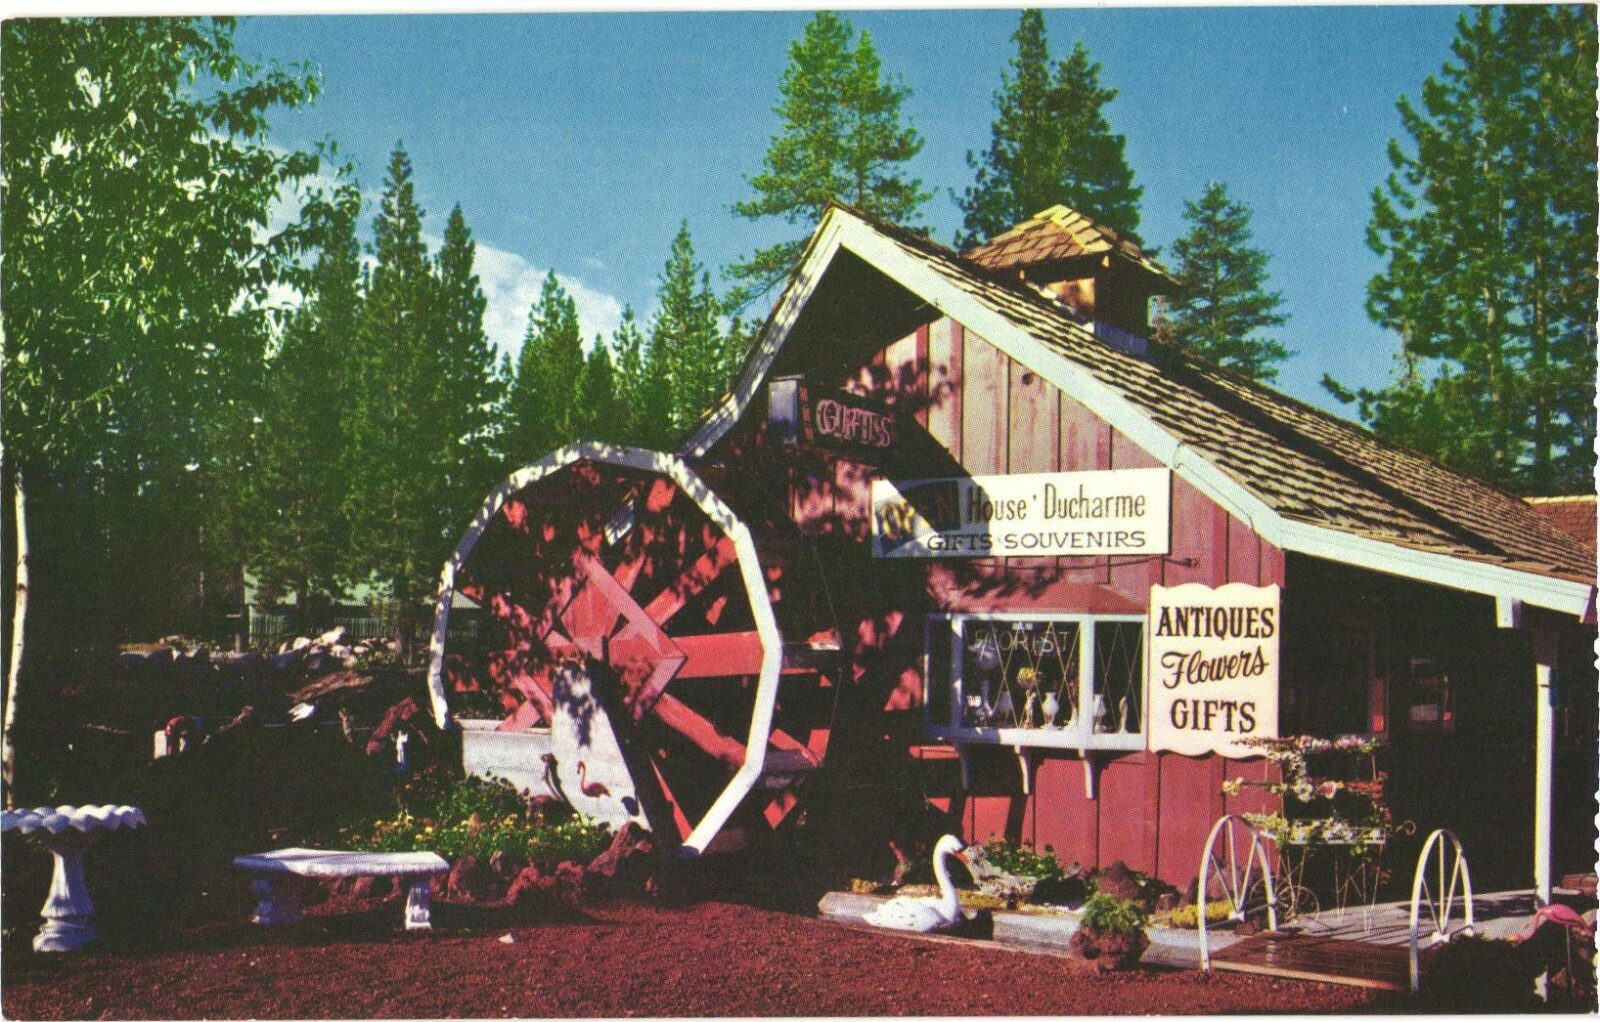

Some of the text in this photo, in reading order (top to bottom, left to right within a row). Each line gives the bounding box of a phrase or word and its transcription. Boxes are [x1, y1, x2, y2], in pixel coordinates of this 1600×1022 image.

[966, 485, 1027, 522] House
[1044, 483, 1146, 520] Ducharme
[927, 530, 1146, 551] GIFTS SOUVENIRS
[1155, 606, 1274, 640] ANTIQUES
[1161, 645, 1270, 689] Flowers
[1170, 698, 1256, 734] GIFTS
